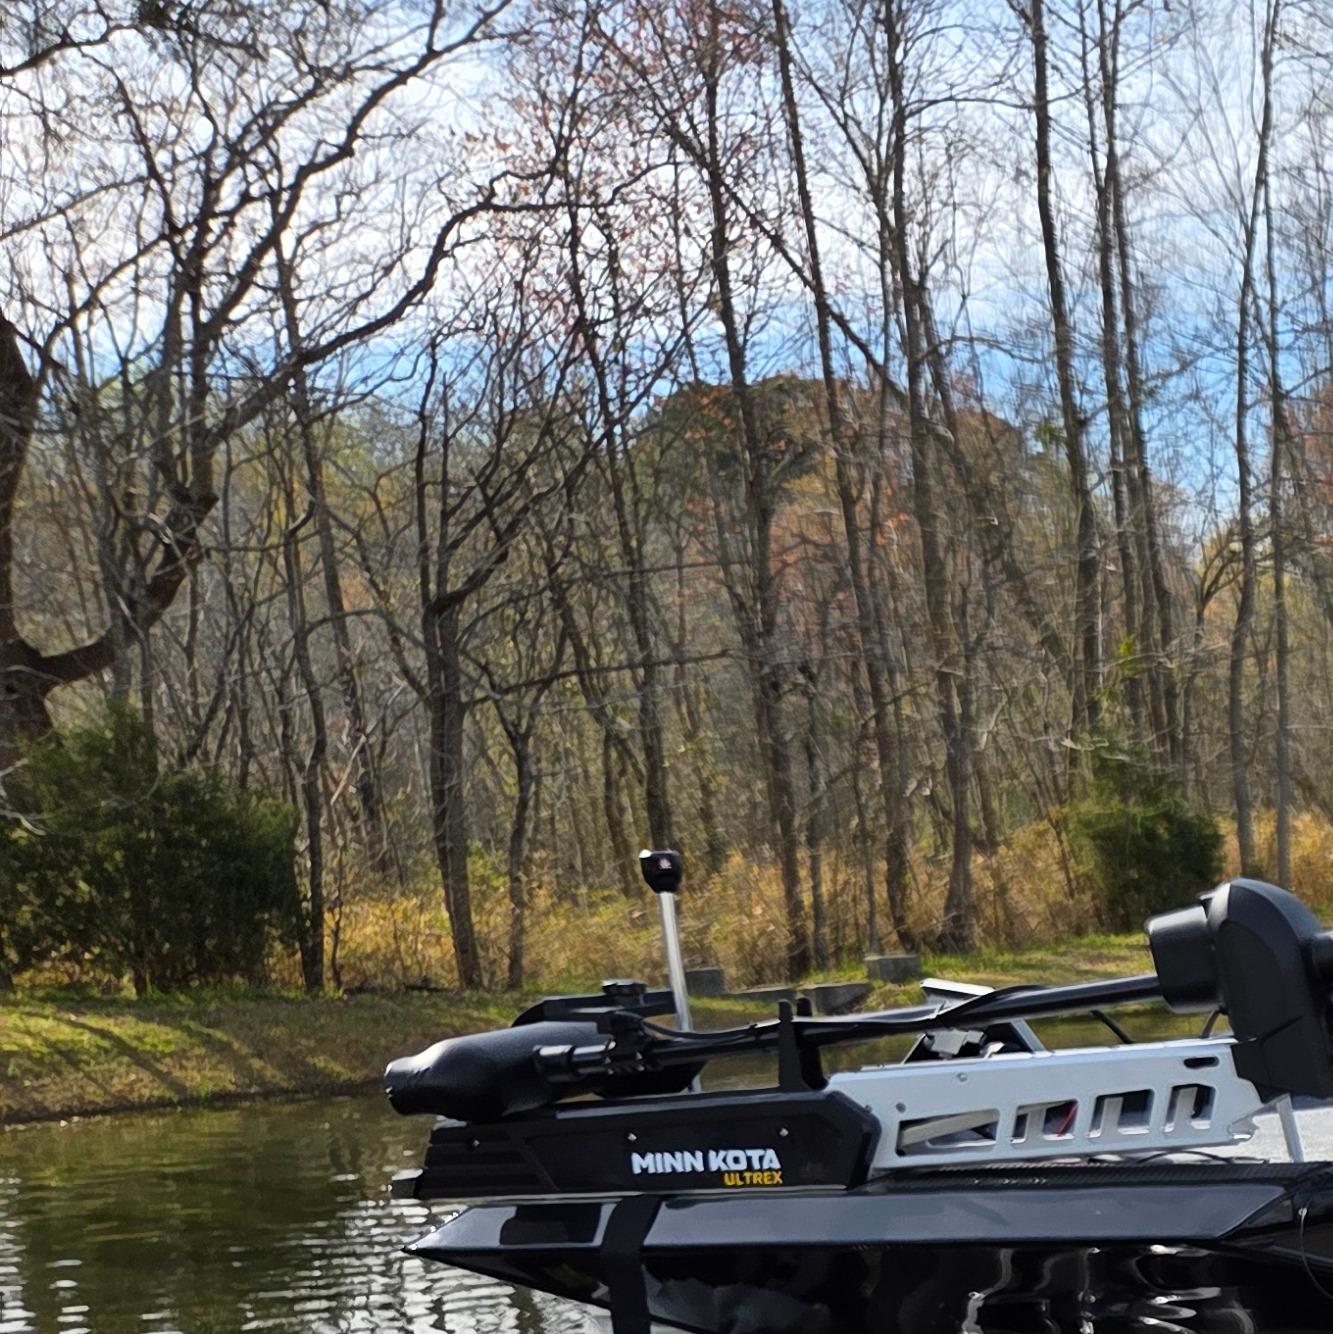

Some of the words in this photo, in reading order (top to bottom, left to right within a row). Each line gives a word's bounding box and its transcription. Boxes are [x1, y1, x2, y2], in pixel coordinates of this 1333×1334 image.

[631, 1150, 705, 1175] MINN
[708, 1148, 781, 1172] KOTA
[723, 1170, 783, 1186] ULTREX
